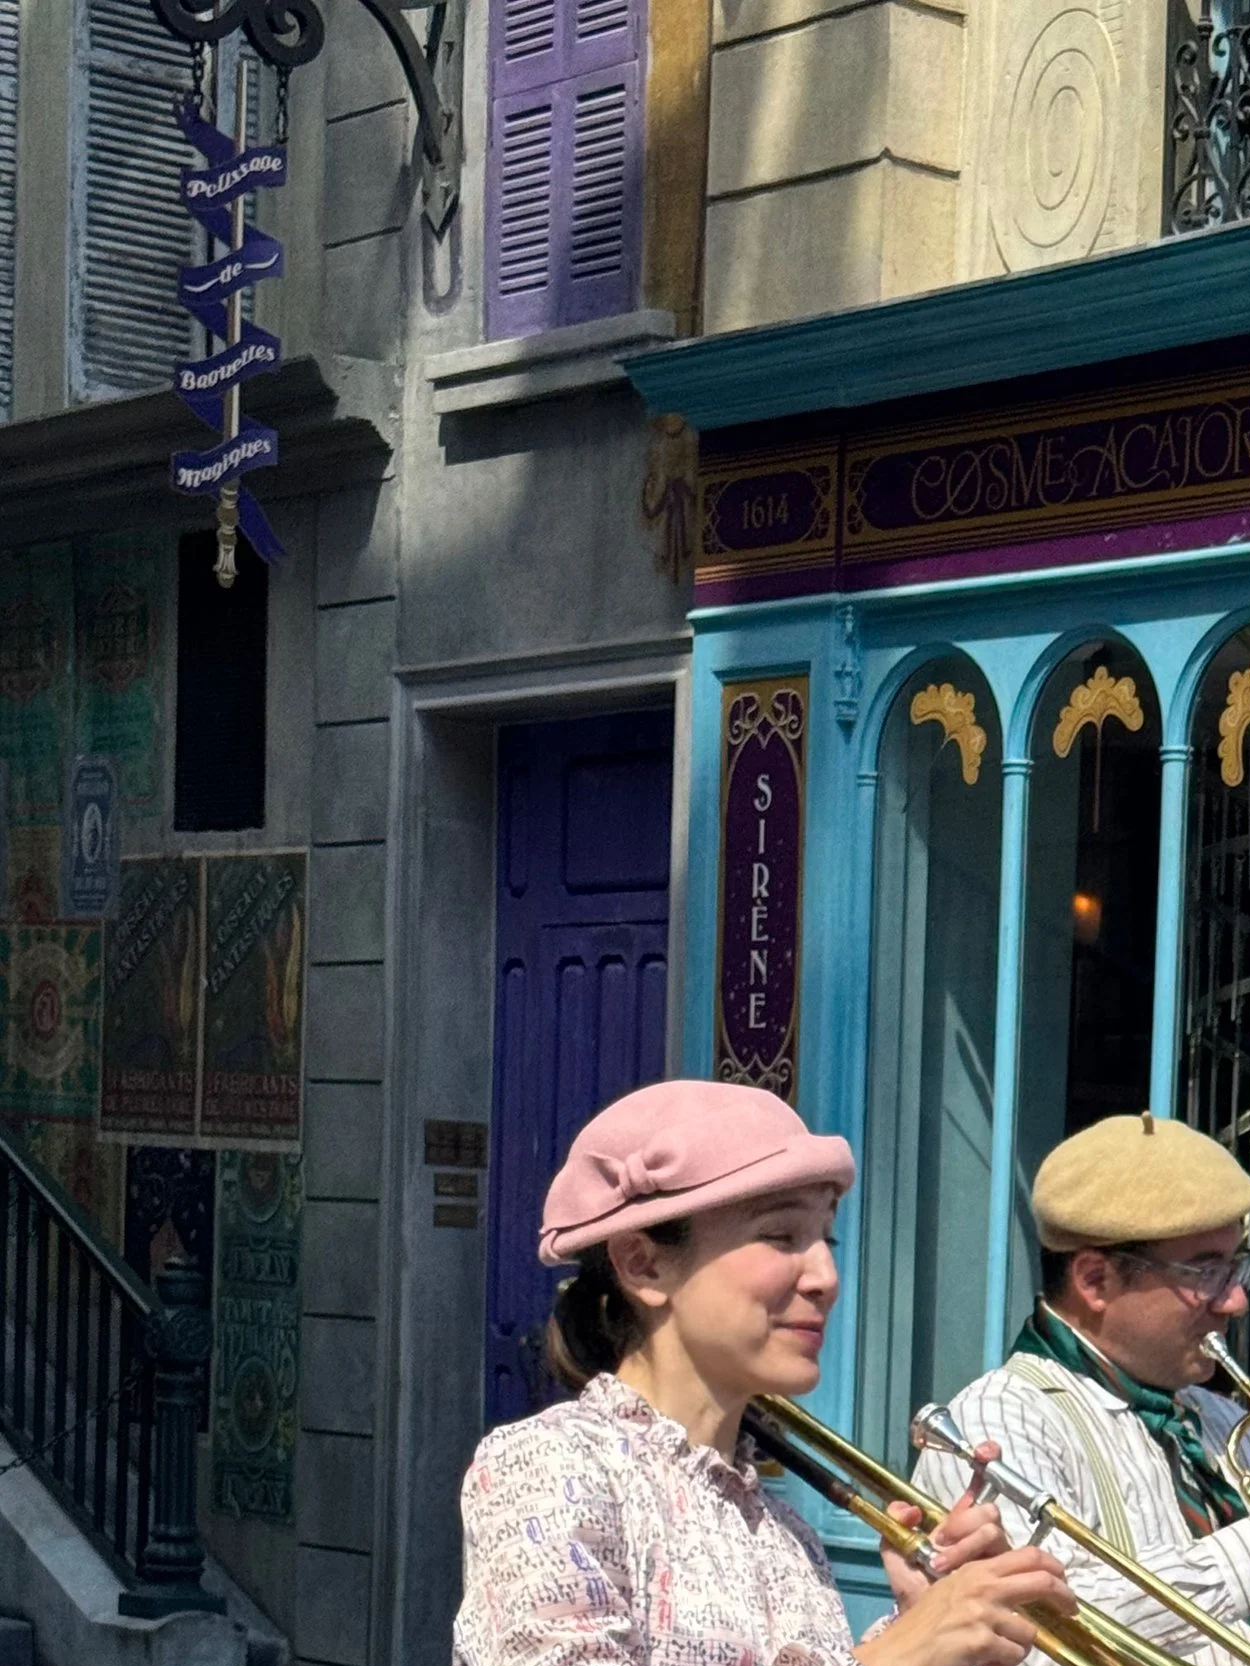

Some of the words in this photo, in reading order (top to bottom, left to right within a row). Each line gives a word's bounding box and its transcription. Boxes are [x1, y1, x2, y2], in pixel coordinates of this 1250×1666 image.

[186, 155, 283, 198] Polissage
[220, 262, 243, 284] de
[179, 345, 276, 391] Baguettes
[178, 437, 272, 487] Magiques
[740, 494, 789, 530] 1614
